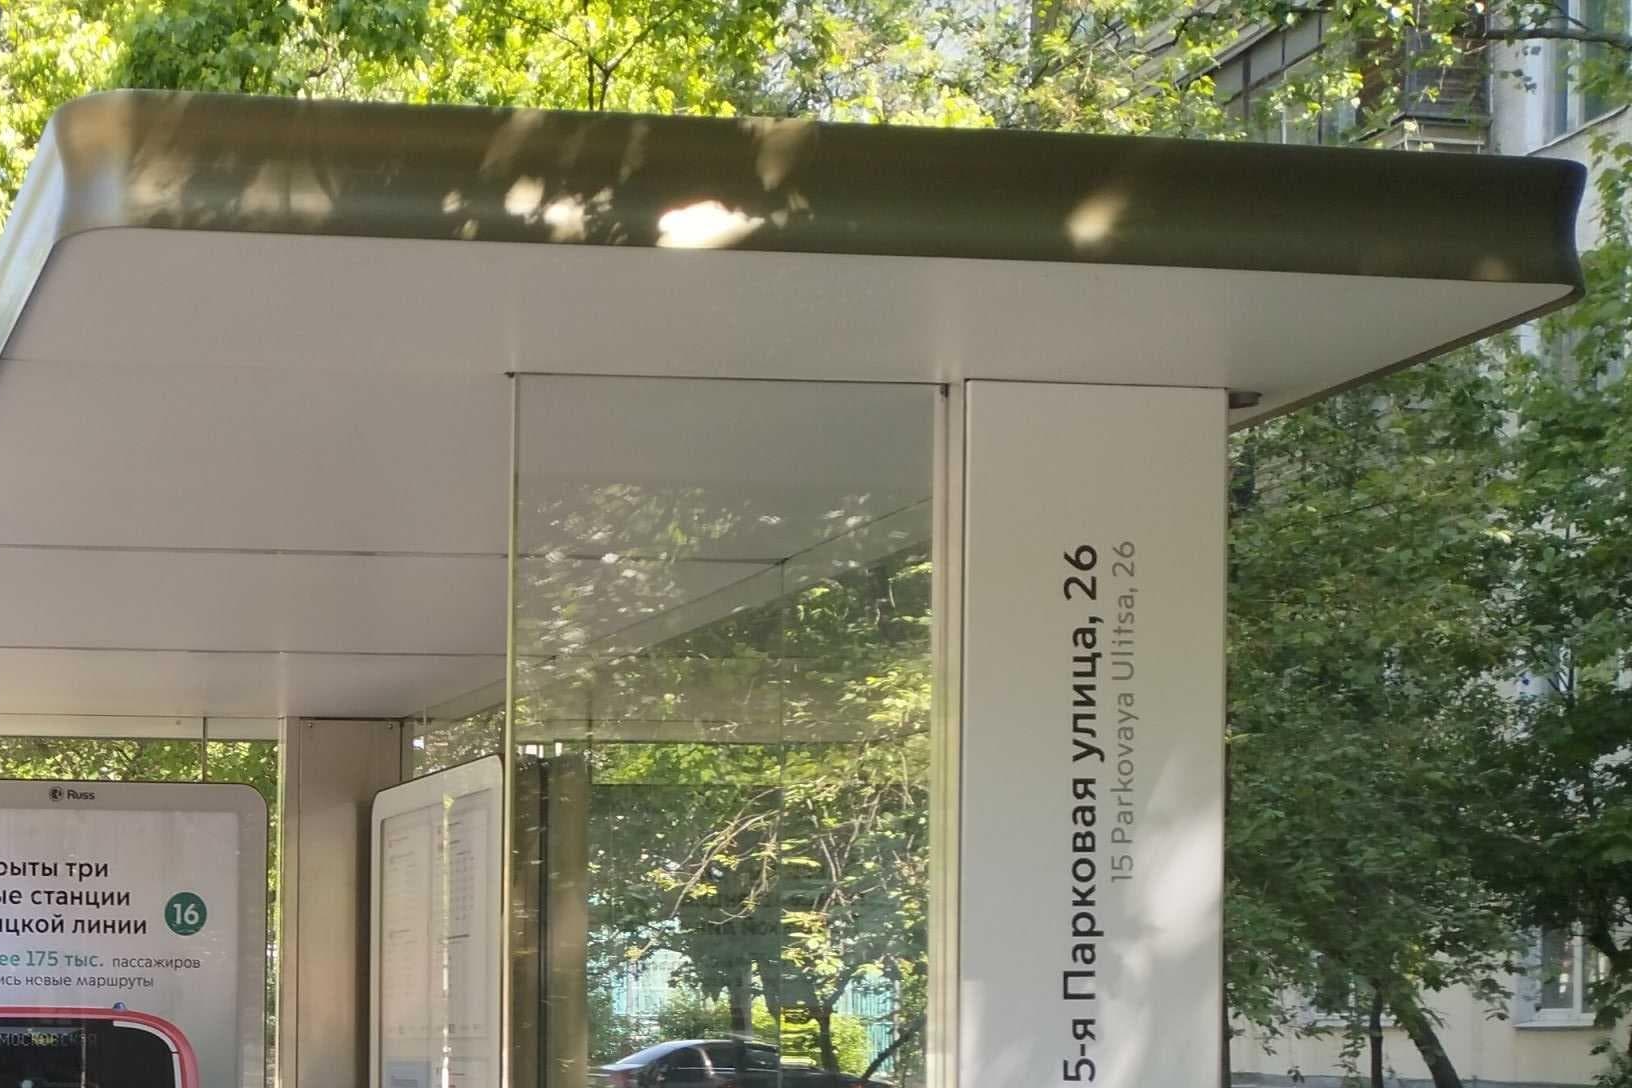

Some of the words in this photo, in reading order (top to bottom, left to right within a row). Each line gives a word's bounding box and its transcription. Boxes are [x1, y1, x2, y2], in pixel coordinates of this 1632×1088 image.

[1111, 541, 1135, 577] 26
[1063, 544, 1098, 601] 26
[1110, 587, 1139, 681] Ulitsa,
[1072, 616, 1105, 763] улица,
[1110, 692, 1139, 844] Parkovaya
[67, 789, 96, 801] Russ
[65, 862, 108, 883] три
[1111, 854, 1134, 884] 15
[30, 890, 130, 909] станции
[1062, 778, 1105, 1000] Парковая
[71, 919, 147, 935] линии
[173, 903, 200, 925] 16
[26, 950, 59, 967] 175
[63, 954, 104, 968] тыс.
[112, 957, 201, 971] пассажиров
[25, 976, 72, 987] новые
[76, 976, 154, 990] маршруты
